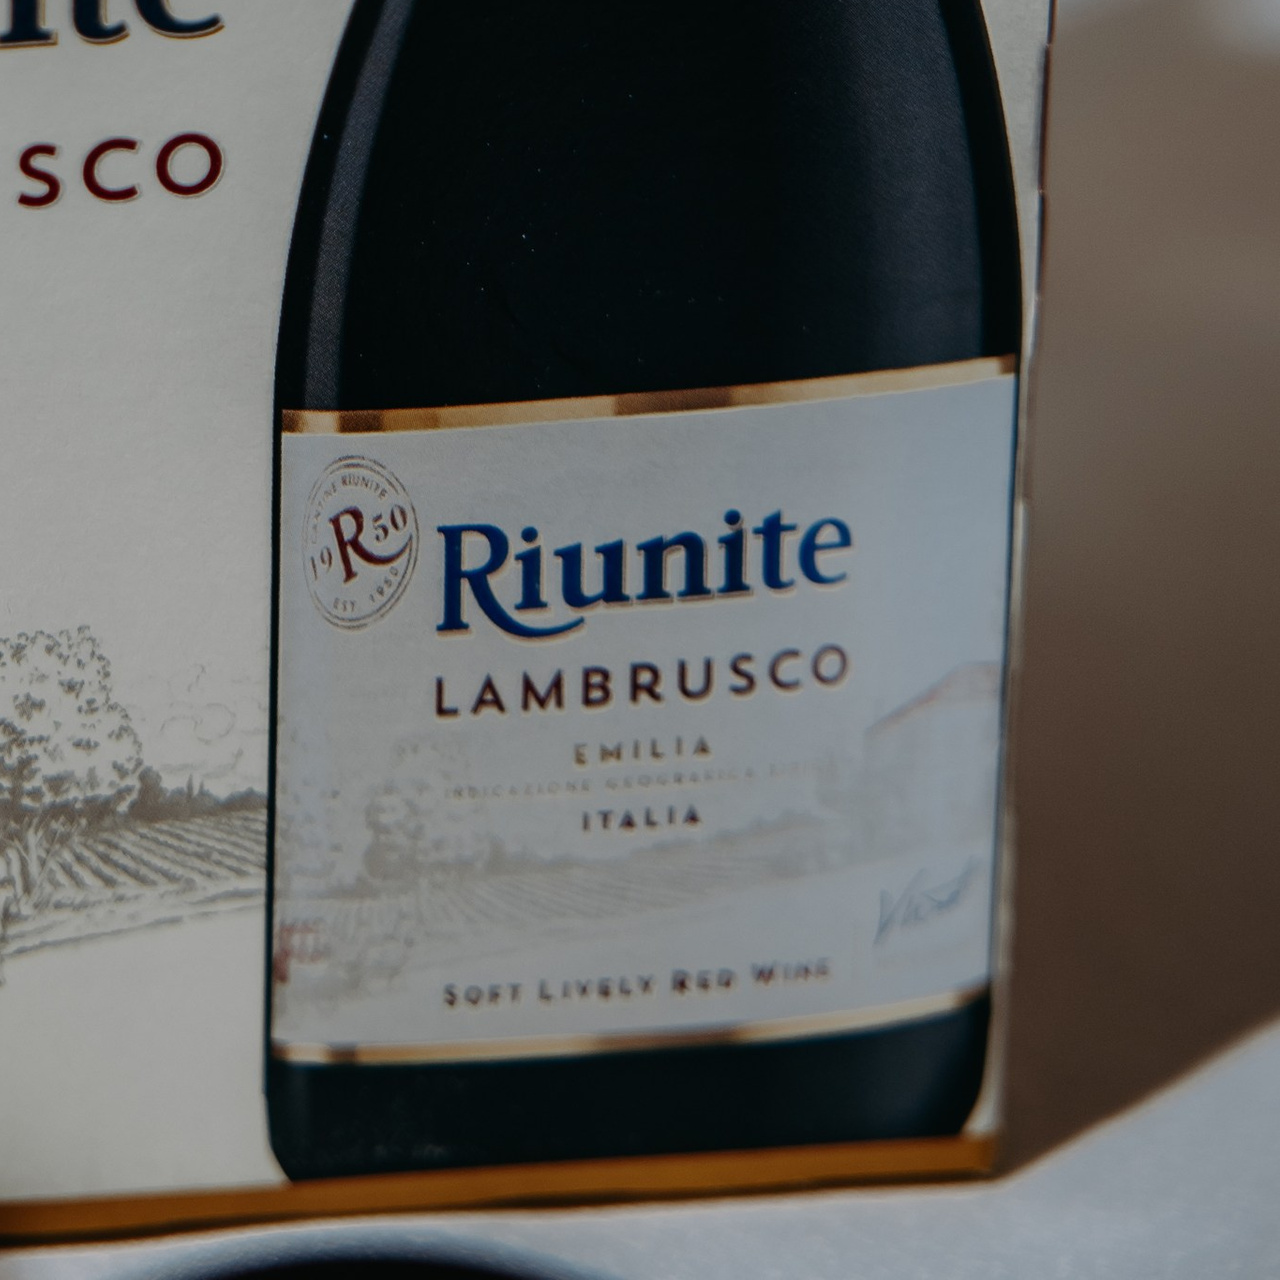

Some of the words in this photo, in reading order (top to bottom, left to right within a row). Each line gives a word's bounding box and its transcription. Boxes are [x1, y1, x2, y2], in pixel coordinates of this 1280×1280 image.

[341, 474, 387, 500] RIUNITE
[328, 505, 413, 583] R
[372, 504, 408, 543] 50
[435, 509, 853, 639] Riunite
[433, 643, 851, 719] LAMBRUSCO
[572, 735, 713, 768] EMILIA
[581, 804, 703, 834] ITALIA
[442, 981, 523, 1009] SOFT
[536, 974, 655, 1004] LIVELY
[670, 968, 736, 995] RED
[749, 957, 831, 987] WINE
